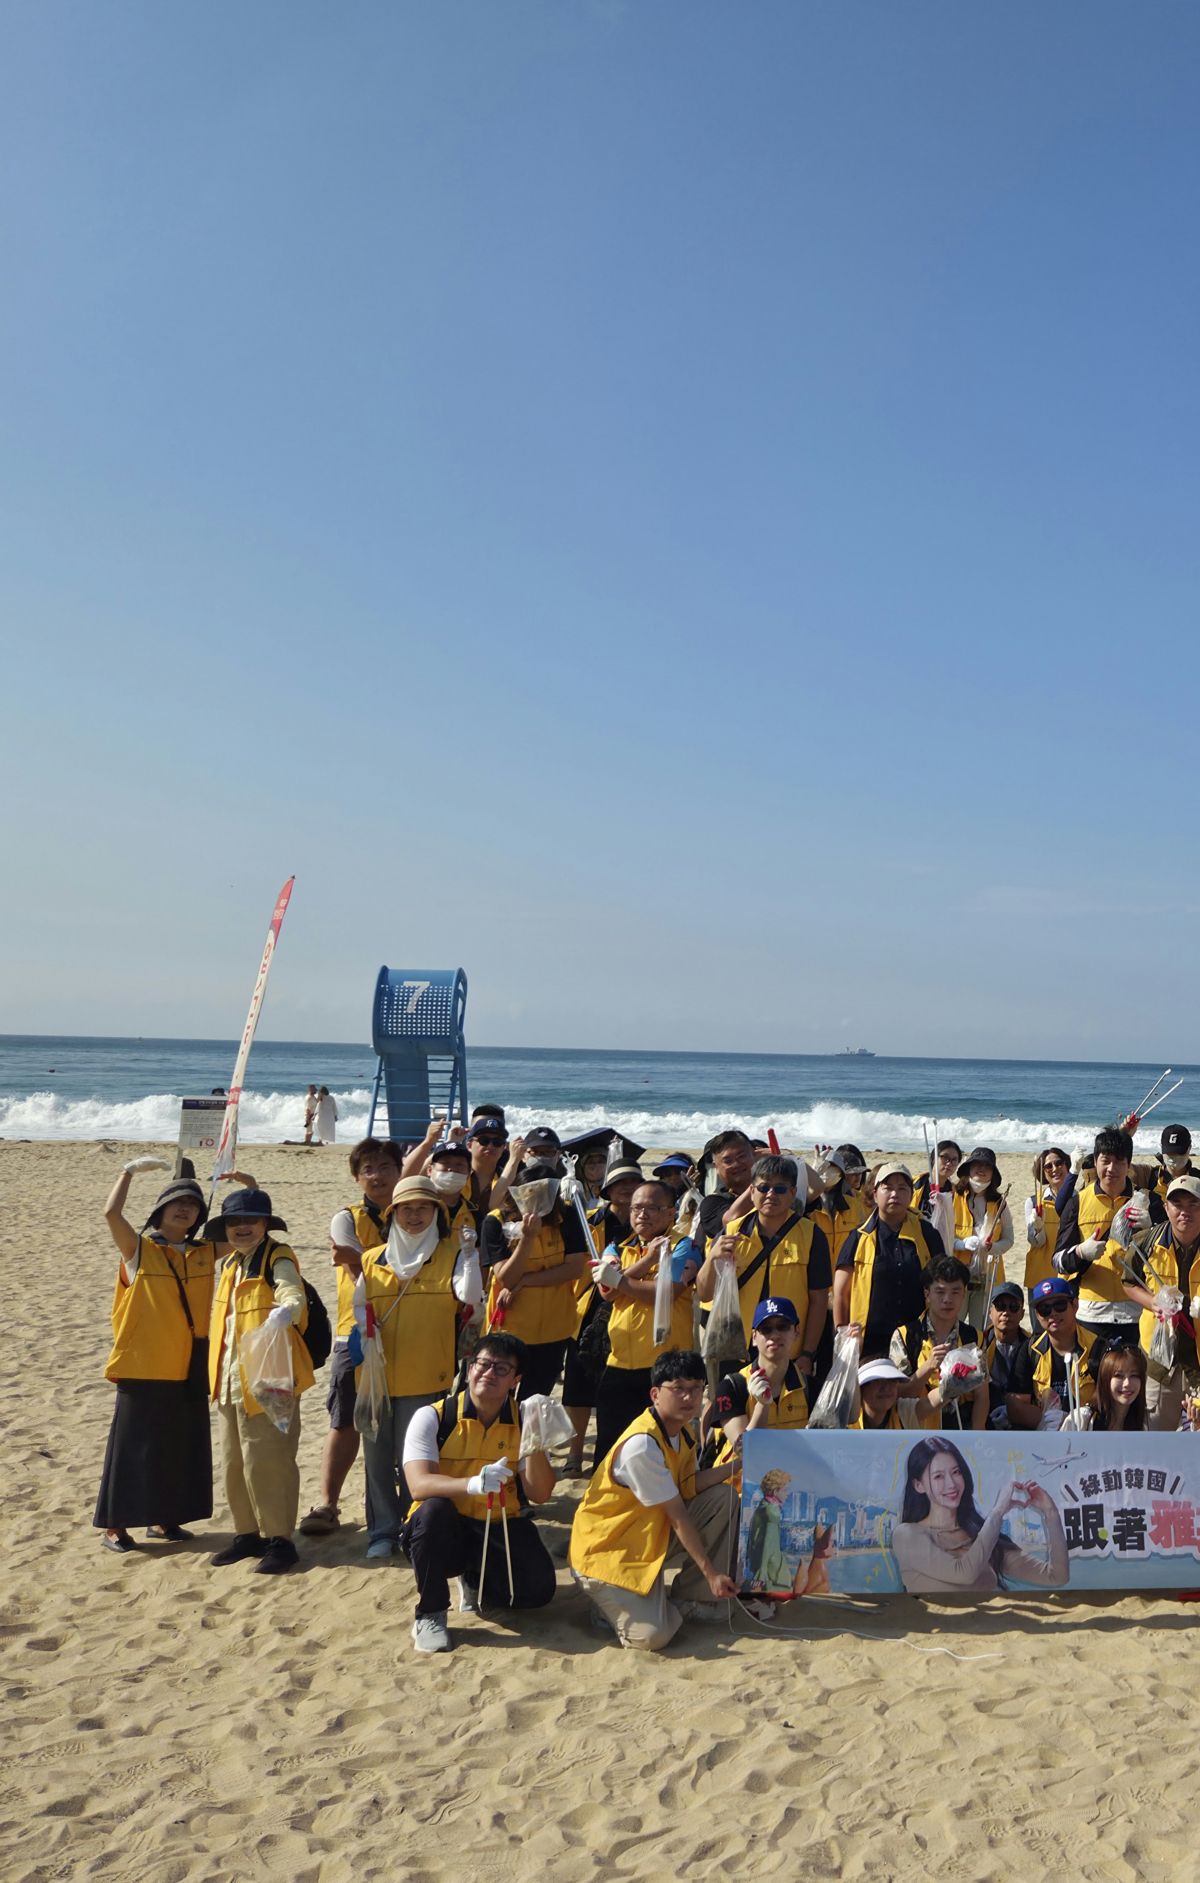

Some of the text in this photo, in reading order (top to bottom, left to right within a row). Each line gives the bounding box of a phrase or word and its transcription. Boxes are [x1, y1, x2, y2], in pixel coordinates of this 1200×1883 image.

[403, 981, 430, 1013] 7
[1169, 1133, 1178, 1144] G
[766, 1299, 778, 1313] LA
